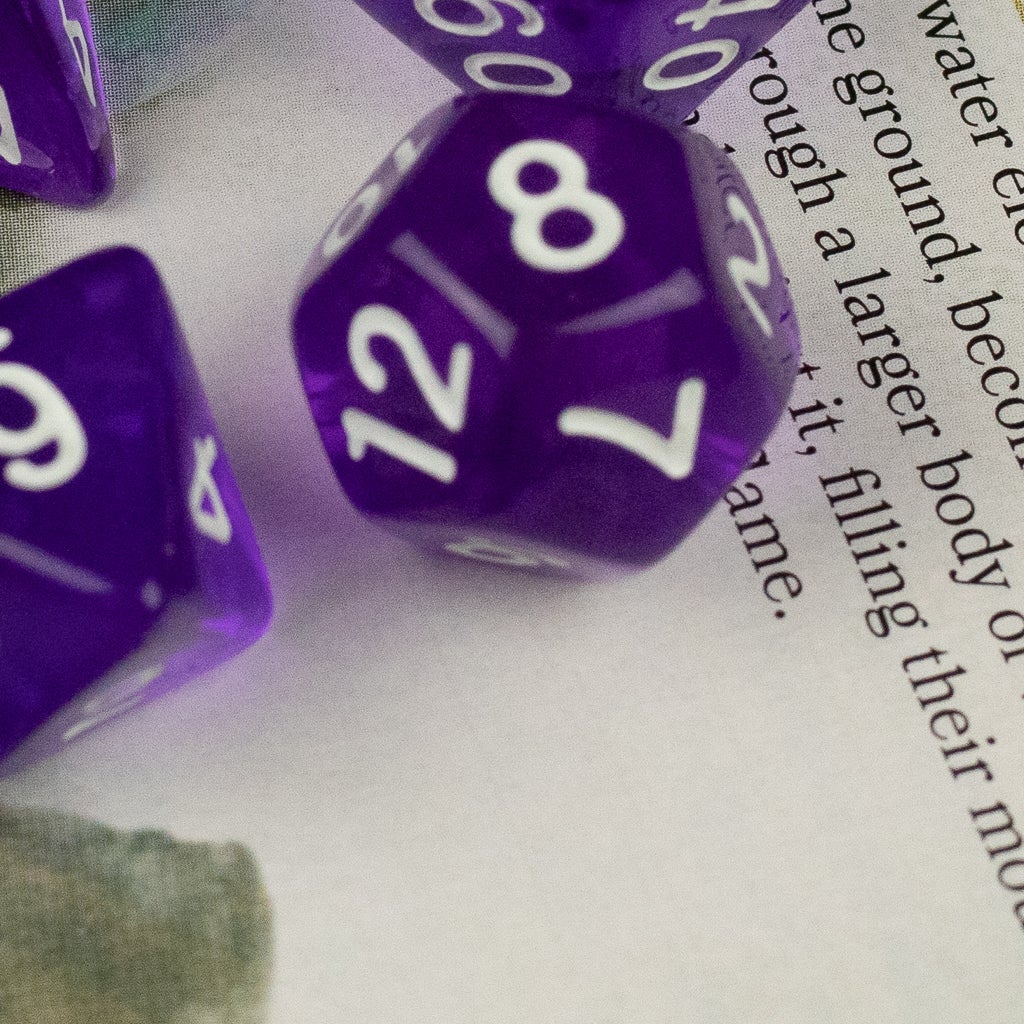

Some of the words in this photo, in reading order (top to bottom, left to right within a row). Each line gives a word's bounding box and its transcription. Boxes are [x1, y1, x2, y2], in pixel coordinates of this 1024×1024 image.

[749, 46, 849, 215] rough
[832, 69, 982, 285] ground,
[486, 139, 625, 272] 8
[814, 227, 856, 262] a
[341, 303, 472, 483] 12
[833, 267, 942, 437] larger
[188, 434, 232, 544] 4
[557, 377, 705, 480] 7
[725, 476, 804, 619] ame.
[788, 397, 845, 457] it,
[818, 466, 929, 639] filling
[902, 647, 997, 781] their
[916, 448, 1015, 590] body
